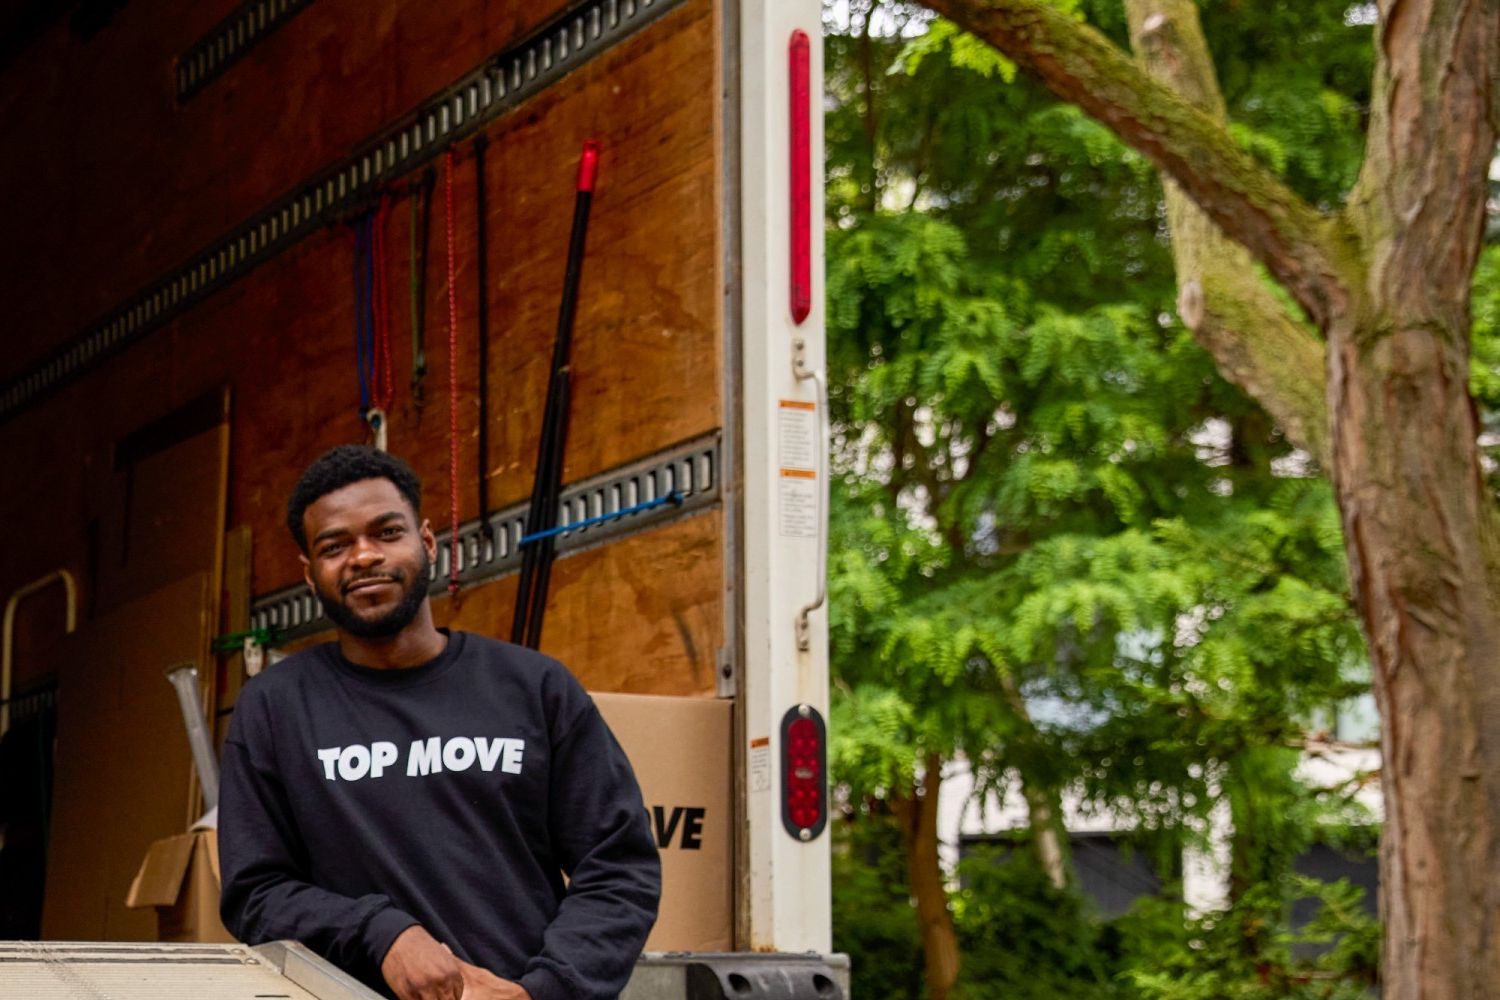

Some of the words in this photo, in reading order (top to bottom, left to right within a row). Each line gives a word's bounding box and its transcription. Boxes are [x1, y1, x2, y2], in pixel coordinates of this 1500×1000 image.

[317, 741, 398, 781] TOP
[406, 736, 525, 775] MOVE
[645, 806, 706, 850] VE
